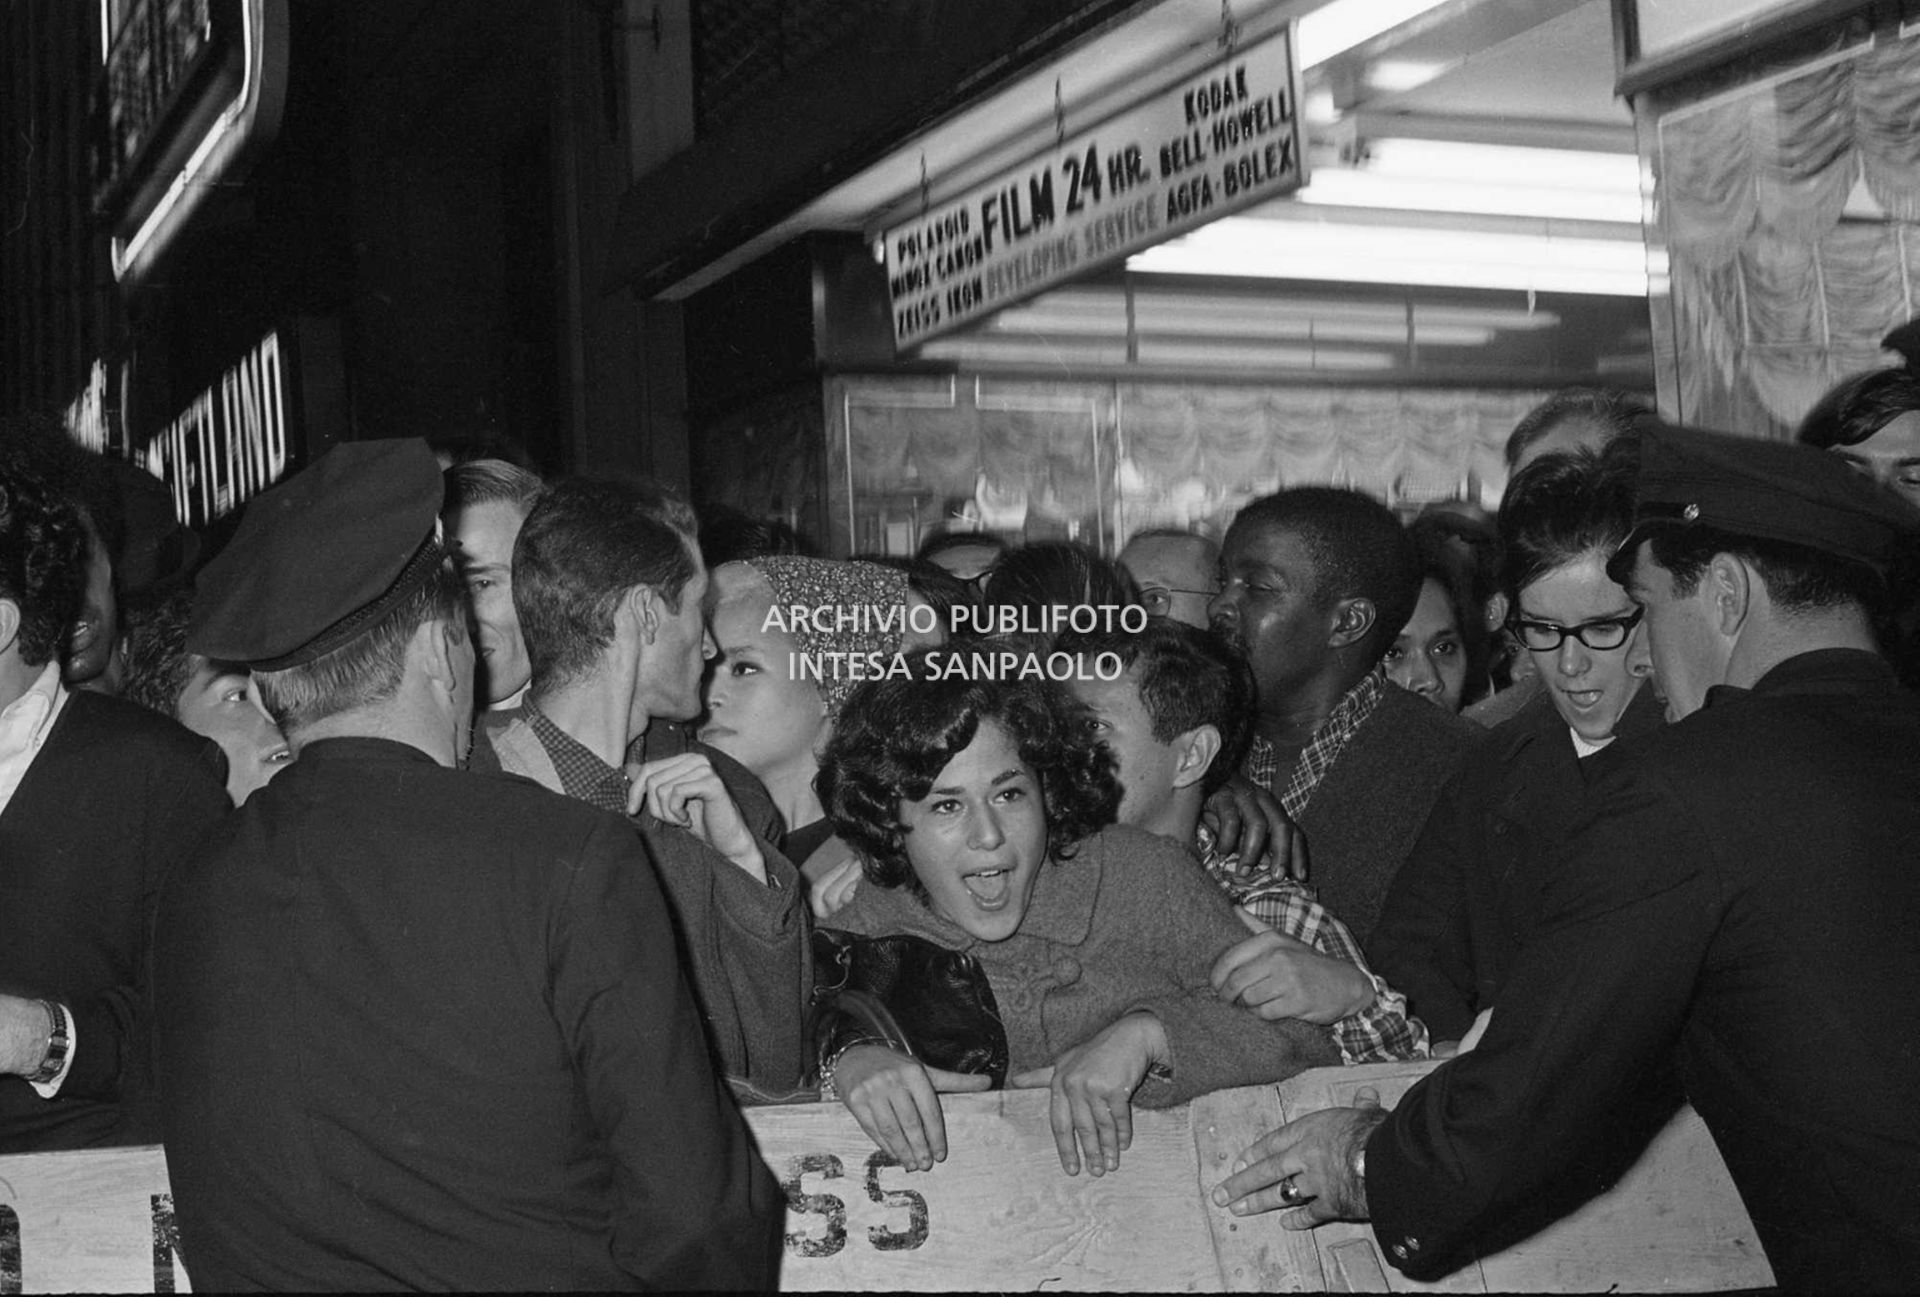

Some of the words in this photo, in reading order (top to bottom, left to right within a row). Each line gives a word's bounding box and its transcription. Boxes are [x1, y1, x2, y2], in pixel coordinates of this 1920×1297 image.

[1184, 64, 1248, 125] KODAK
[981, 166, 1055, 255] FILM
[1062, 141, 1102, 217] 24
[1167, 174, 1213, 222] AGFA
[1223, 136, 1293, 197] BOLEX
[898, 207, 970, 262] POLAROID
[936, 235, 984, 282] CANON
[985, 233, 1078, 299] DEVELOPING
[1084, 193, 1157, 258] SERVICE
[899, 293, 941, 335] ZEISS
[947, 275, 983, 317] IKON
